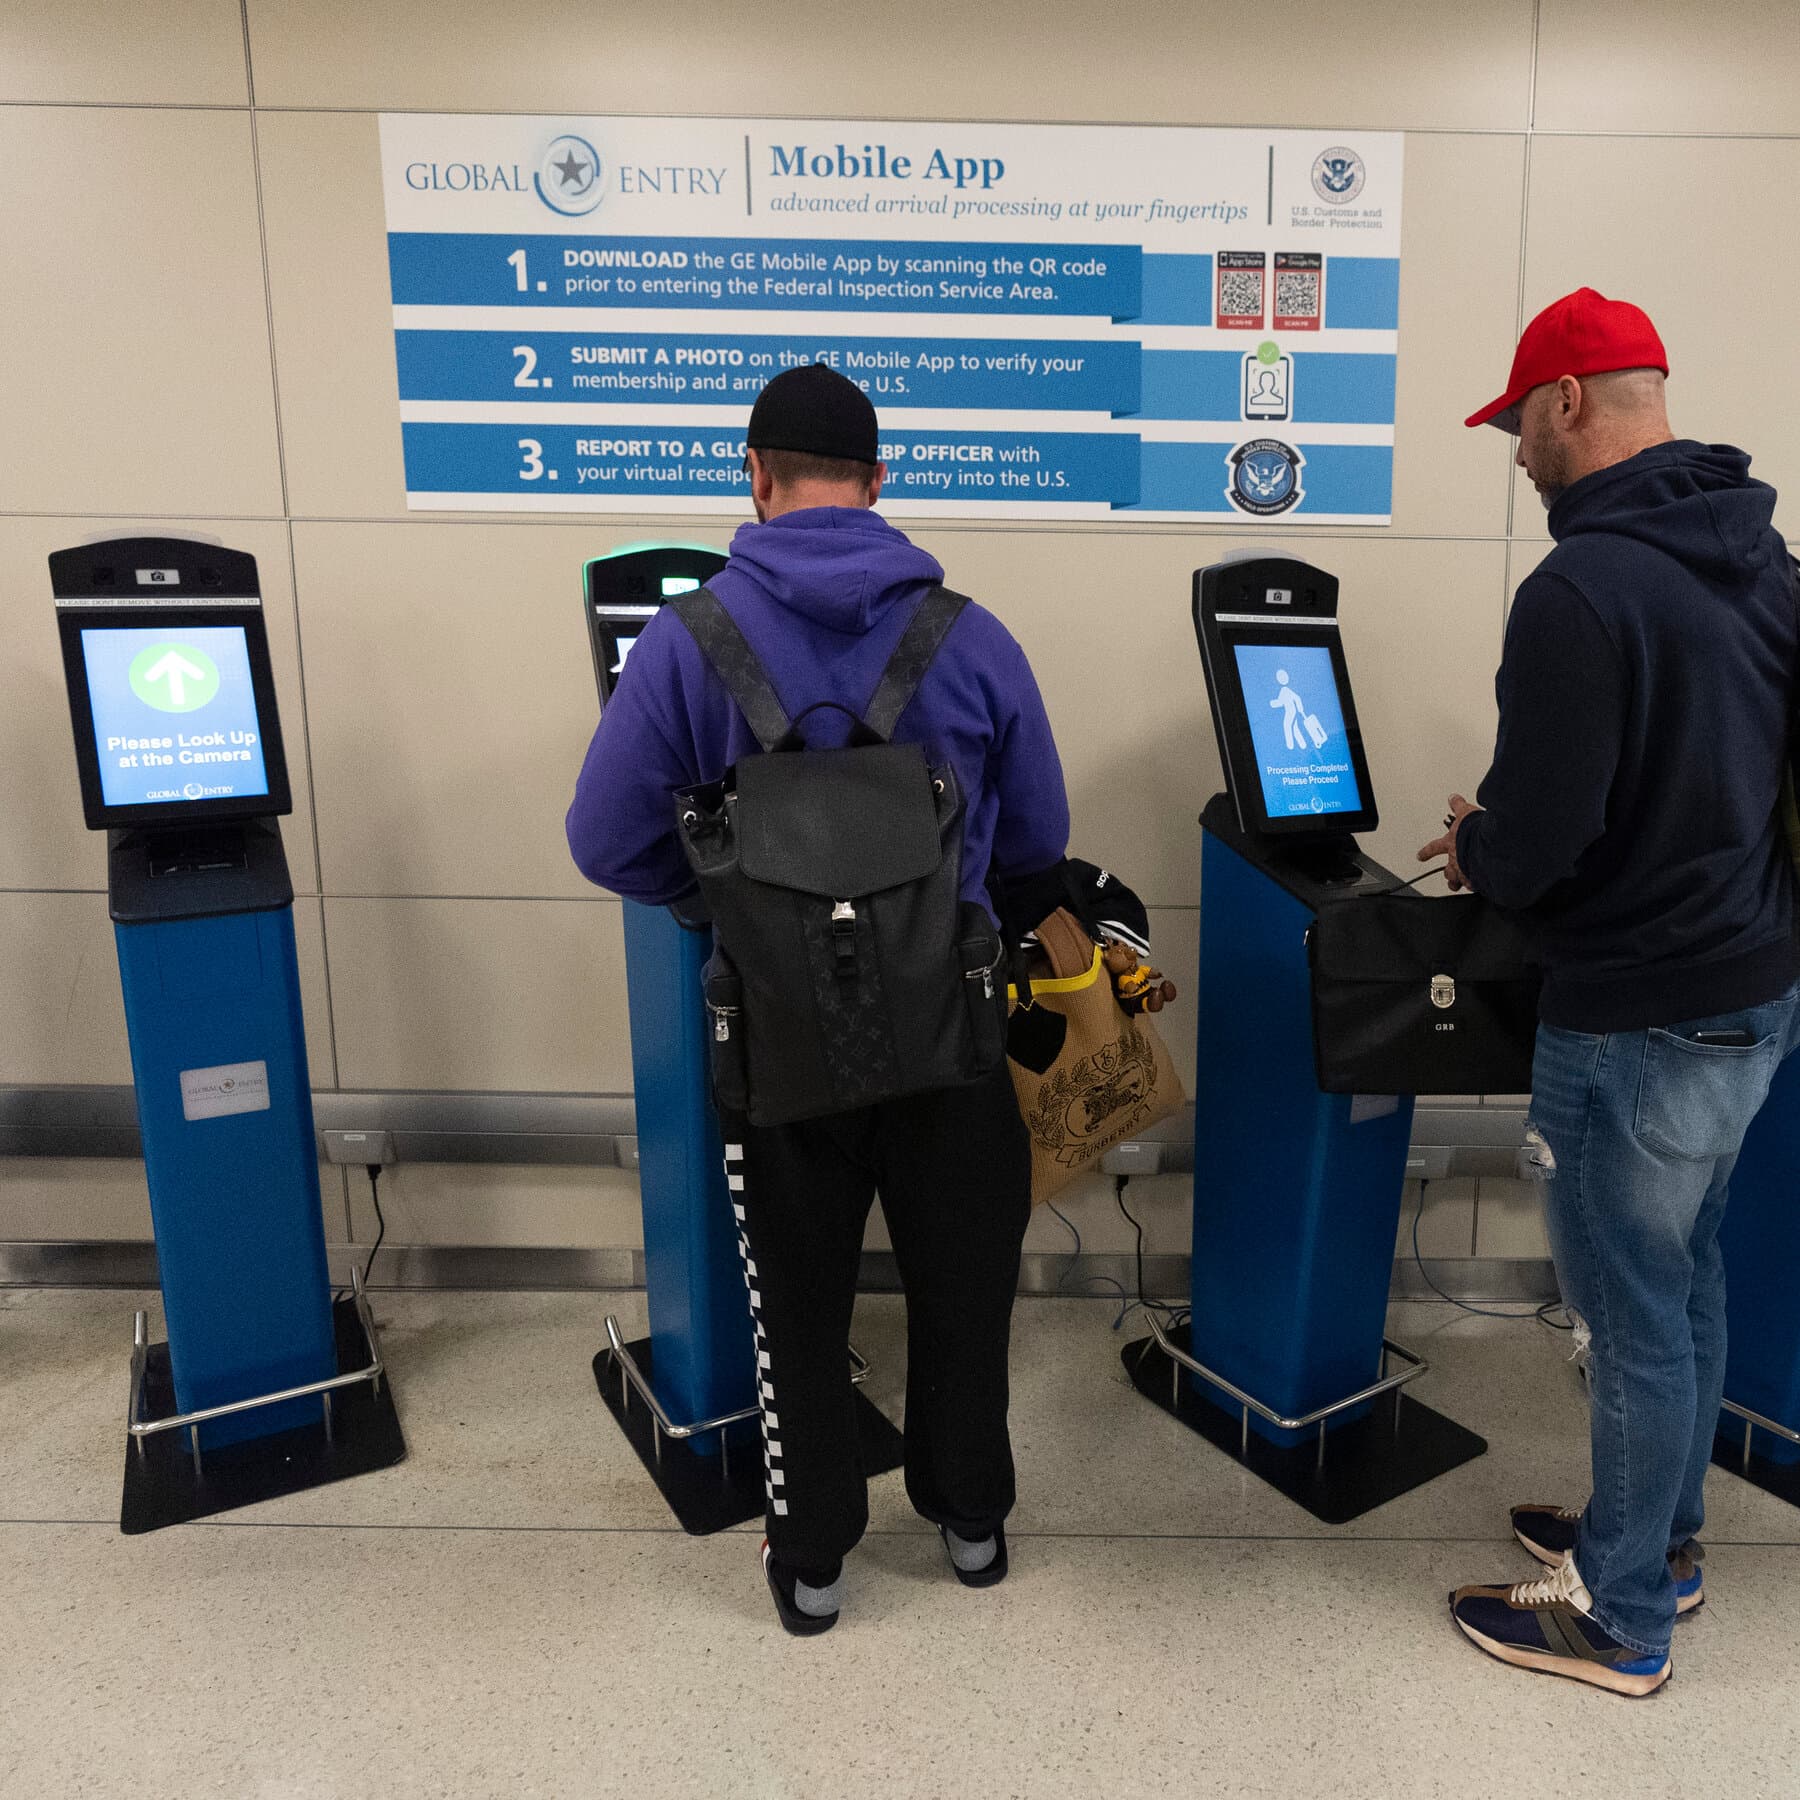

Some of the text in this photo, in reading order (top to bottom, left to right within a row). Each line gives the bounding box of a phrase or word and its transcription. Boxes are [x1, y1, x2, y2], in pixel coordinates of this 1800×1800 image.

[405, 161, 727, 195] GLOBAL ENTRY
[770, 144, 1005, 190] Mobile App
[770, 192, 1248, 224] advanced arrival processing at your fingertips
[1291, 206, 1382, 218] U.S. Customs and
[1291, 218, 1383, 230] Border Protection
[507, 249, 548, 292] 1.
[564, 250, 1107, 278] DOWNLOAD the GE Mobile App by scanning the QR code
[565, 275, 1058, 302] prior to entering the Federal Inspection Service Area.
[512, 345, 553, 388] 2.
[570, 347, 1085, 377] SUBMIT A PHOTO on the GE Mobile App to verify your
[572, 371, 687, 394] membership
[692, 373, 727, 391] and
[876, 376, 910, 392] U.S.
[518, 438, 559, 481] 3.
[576, 439, 652, 457] REPORT
[657, 441, 684, 457] TO
[690, 441, 706, 457] A
[912, 445, 994, 462] OFFICER
[999, 446, 1040, 463] with
[576, 467, 619, 485] your
[624, 463, 683, 481] virtual
[905, 470, 953, 490] entry
[958, 468, 995, 486] into
[1000, 469, 1031, 487] the
[1037, 470, 1070, 488] U.S.
[107, 730, 257, 752] Please Look Up
[119, 748, 252, 768] at the Camera
[1266, 763, 1349, 776] Processing Completed
[146, 785, 234, 799] GLOBAL ENTRY
[1282, 775, 1339, 786] Please Proceed
[1435, 1023, 1455, 1031] GRB
